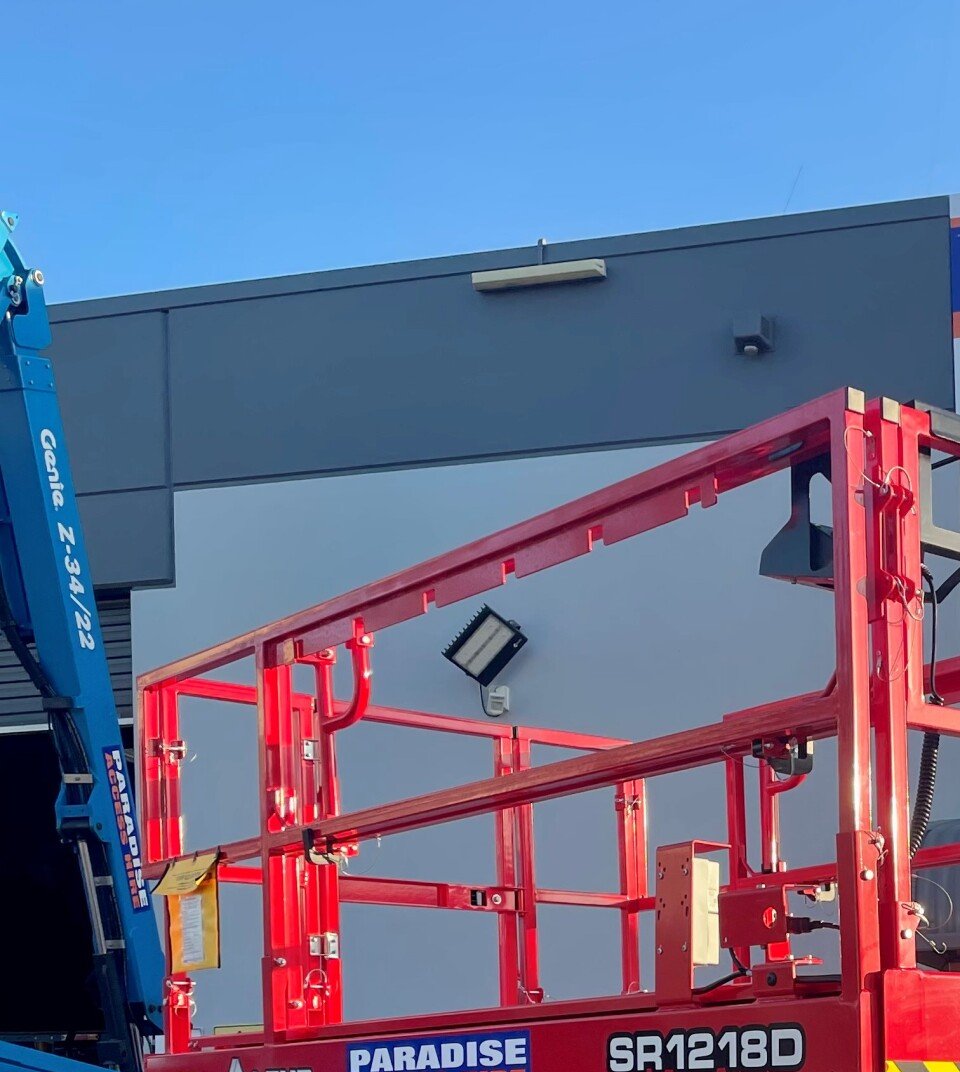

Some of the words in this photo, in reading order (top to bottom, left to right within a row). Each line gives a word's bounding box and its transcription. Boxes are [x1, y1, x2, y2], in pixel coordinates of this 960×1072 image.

[40, 428, 64, 508] Genie
[57, 522, 95, 651] Z-34/22
[105, 752, 128, 846] ACCESS
[112, 750, 149, 907] PARADISE
[609, 1027, 804, 1072] SR1218D
